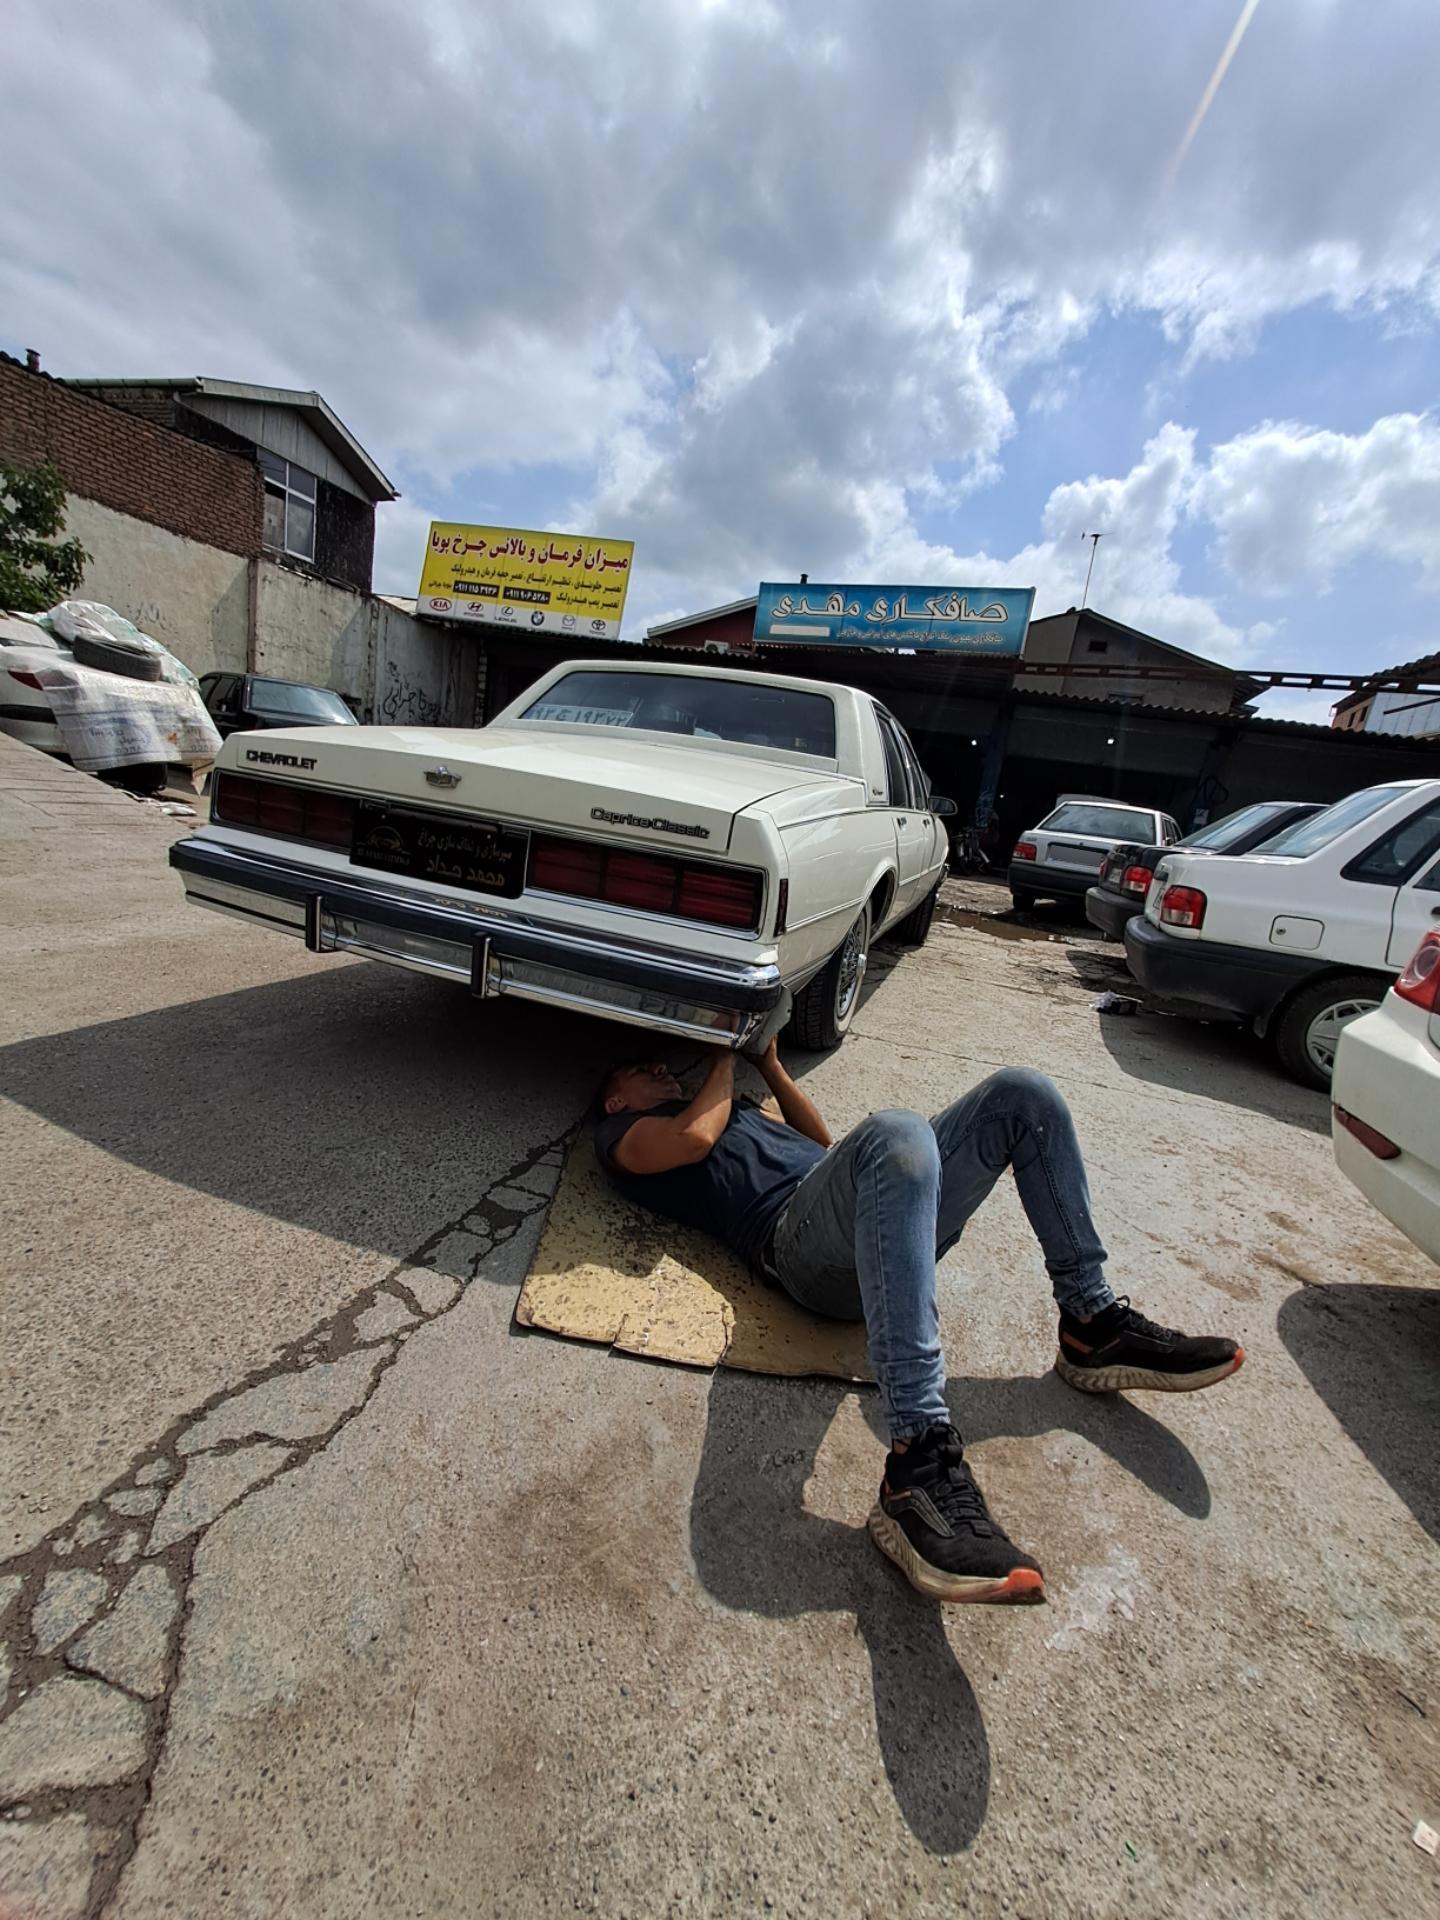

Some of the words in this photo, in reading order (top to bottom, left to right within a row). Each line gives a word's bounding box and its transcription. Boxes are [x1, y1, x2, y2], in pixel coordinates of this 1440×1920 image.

[431, 530, 450, 555] پویا
[452, 534, 487, 559] چرخ
[489, 535, 526, 560] بالانس
[527, 547, 535, 563] و
[538, 542, 582, 569] فرمان
[584, 547, 629, 574] میزان
[432, 600, 448, 610] KIA
[600, 599, 620, 610] تعمیر
[771, 591, 862, 618] مهدی
[865, 591, 1009, 625] صافکاری
[246, 749, 318, 771] CHEVROLET
[591, 806, 650, 829] Caprice
[652, 817, 711, 840] Classic
[425, 853, 463, 879] حداد
[466, 867, 506, 888] محمد
